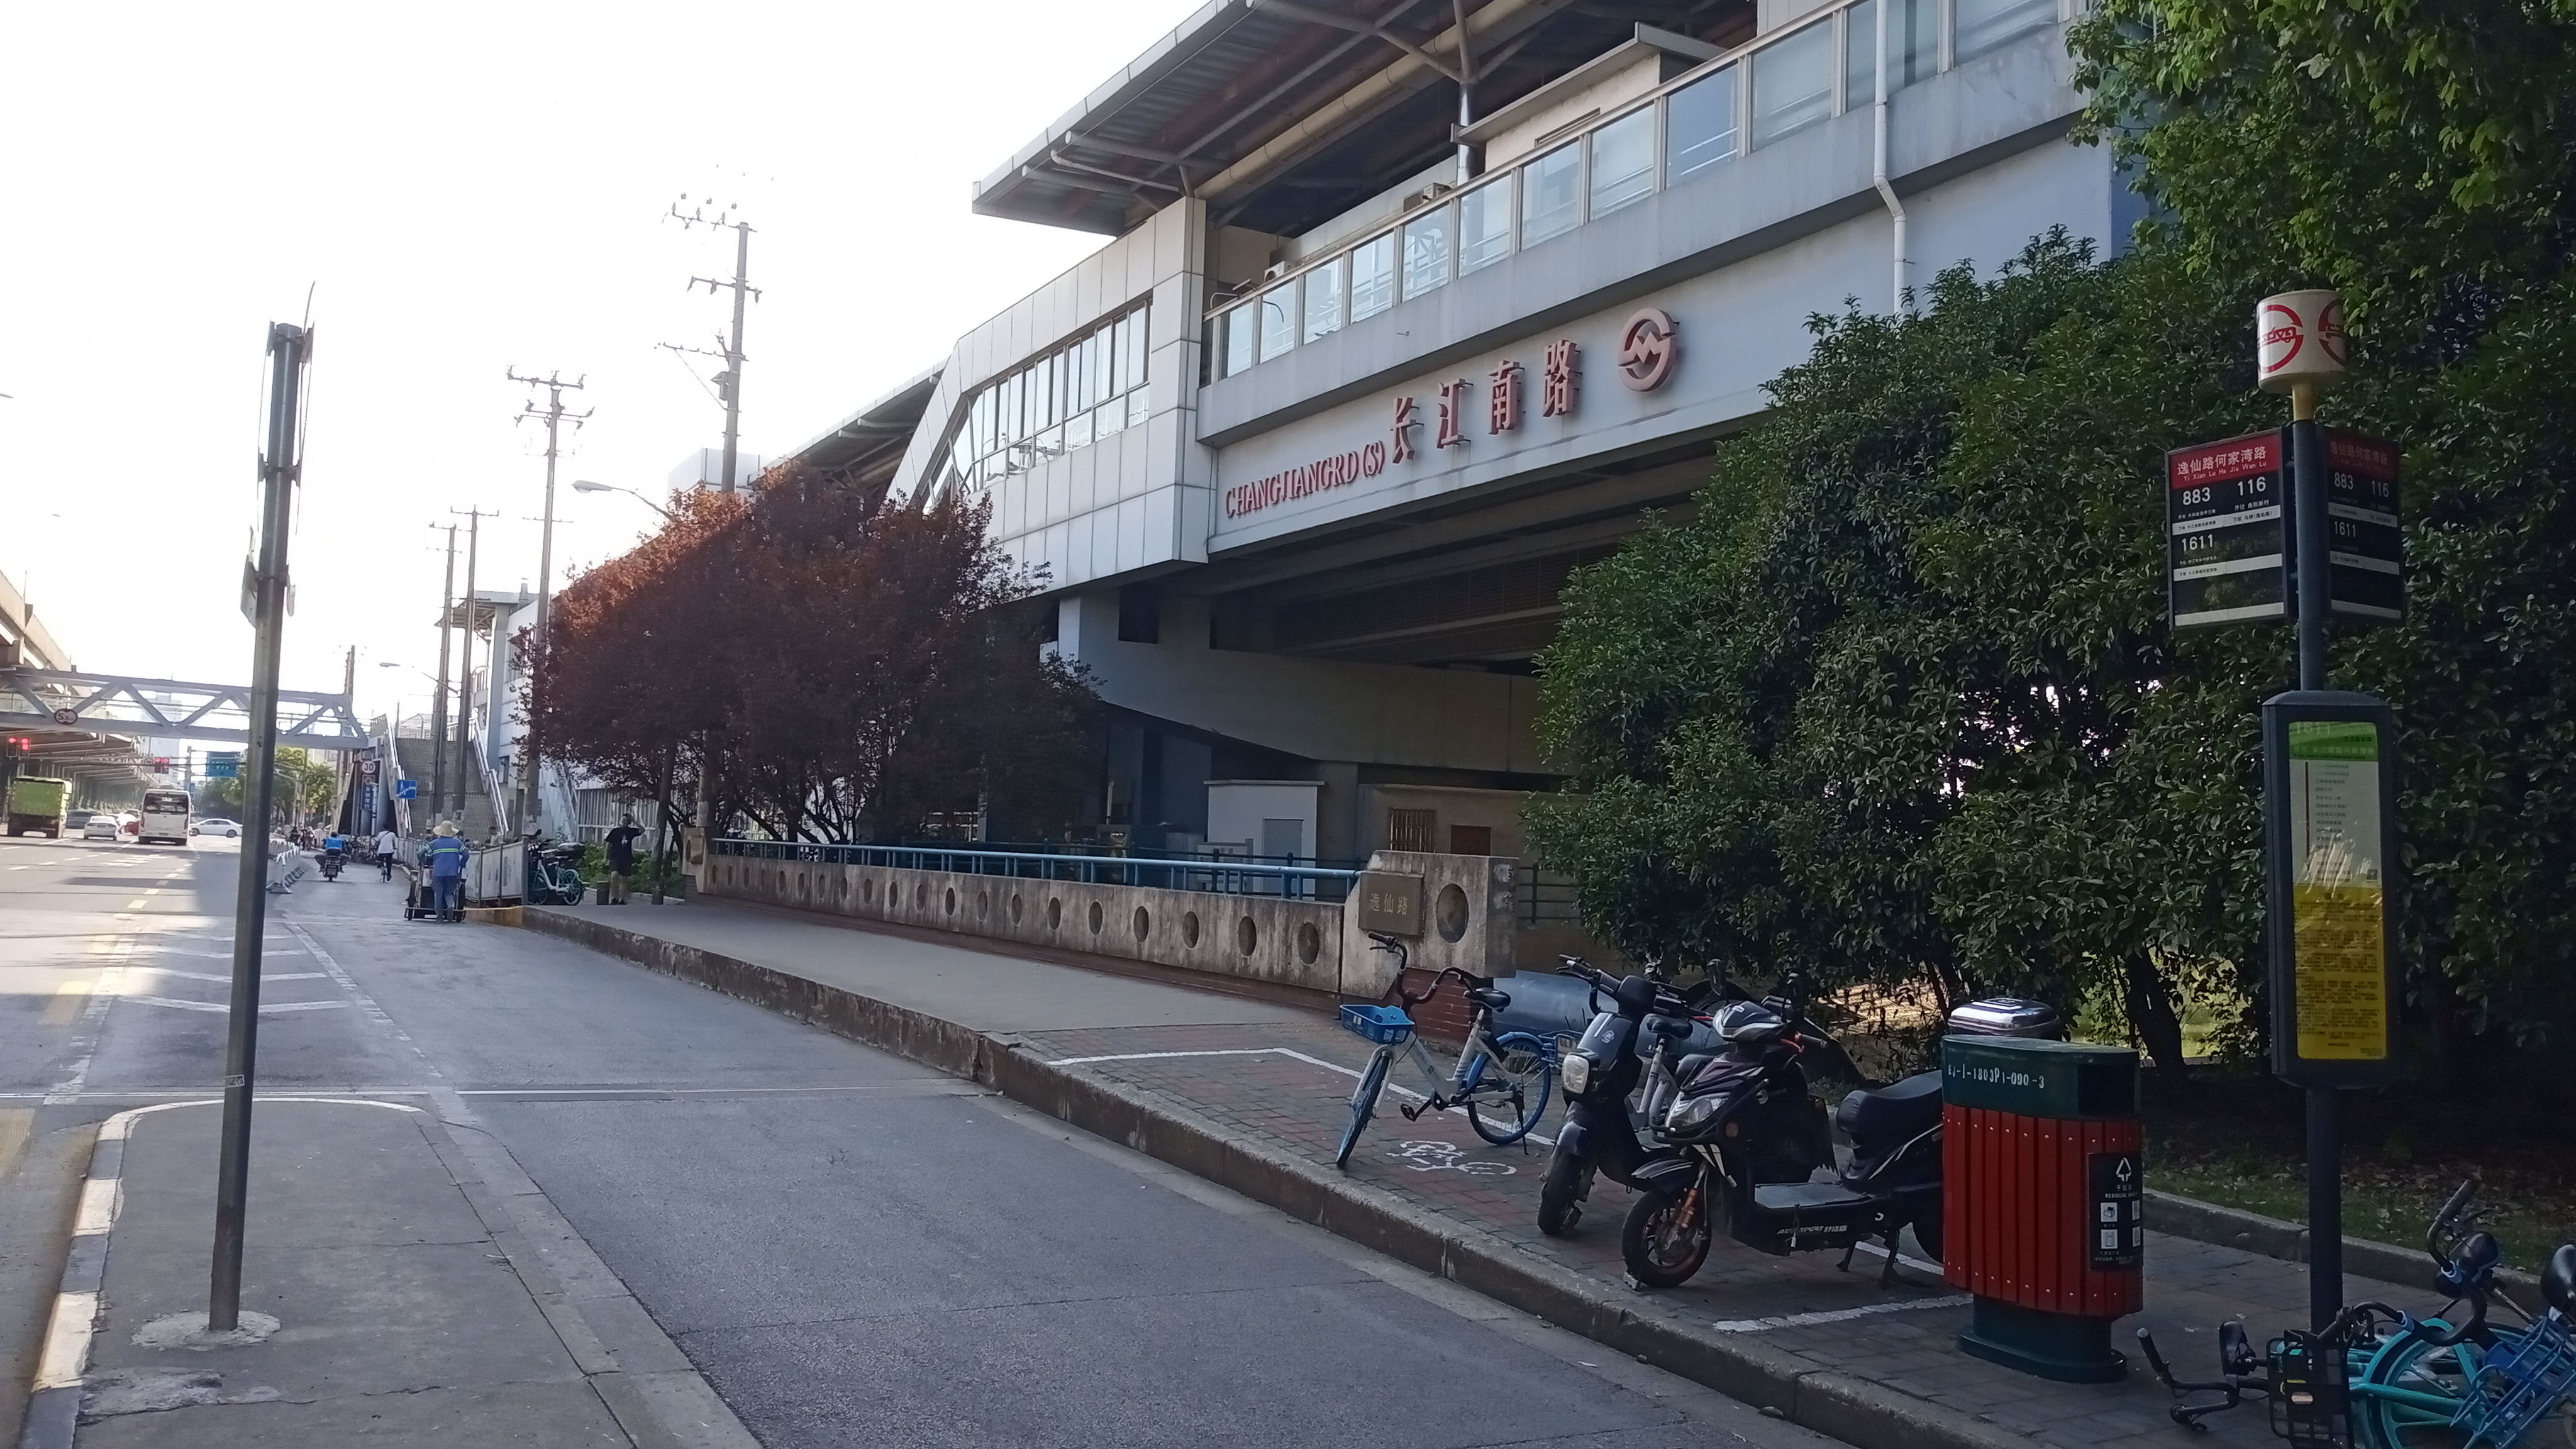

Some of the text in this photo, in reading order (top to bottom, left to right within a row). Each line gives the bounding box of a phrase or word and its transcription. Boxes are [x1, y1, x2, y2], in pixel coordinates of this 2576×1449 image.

[1389, 339, 1577, 464] 长江南路
[2177, 446, 2267, 475] 逸仙路何家湾路
[2237, 476, 2267, 496] 116
[2334, 471, 2354, 490] 883
[2371, 479, 2389, 497] 116
[2182, 487, 2211, 506] 883
[2334, 520, 2357, 538] 1611
[2181, 533, 2213, 552] 1611
[364, 763, 374, 771] 30
[1369, 893, 1409, 916] 逸仙路
